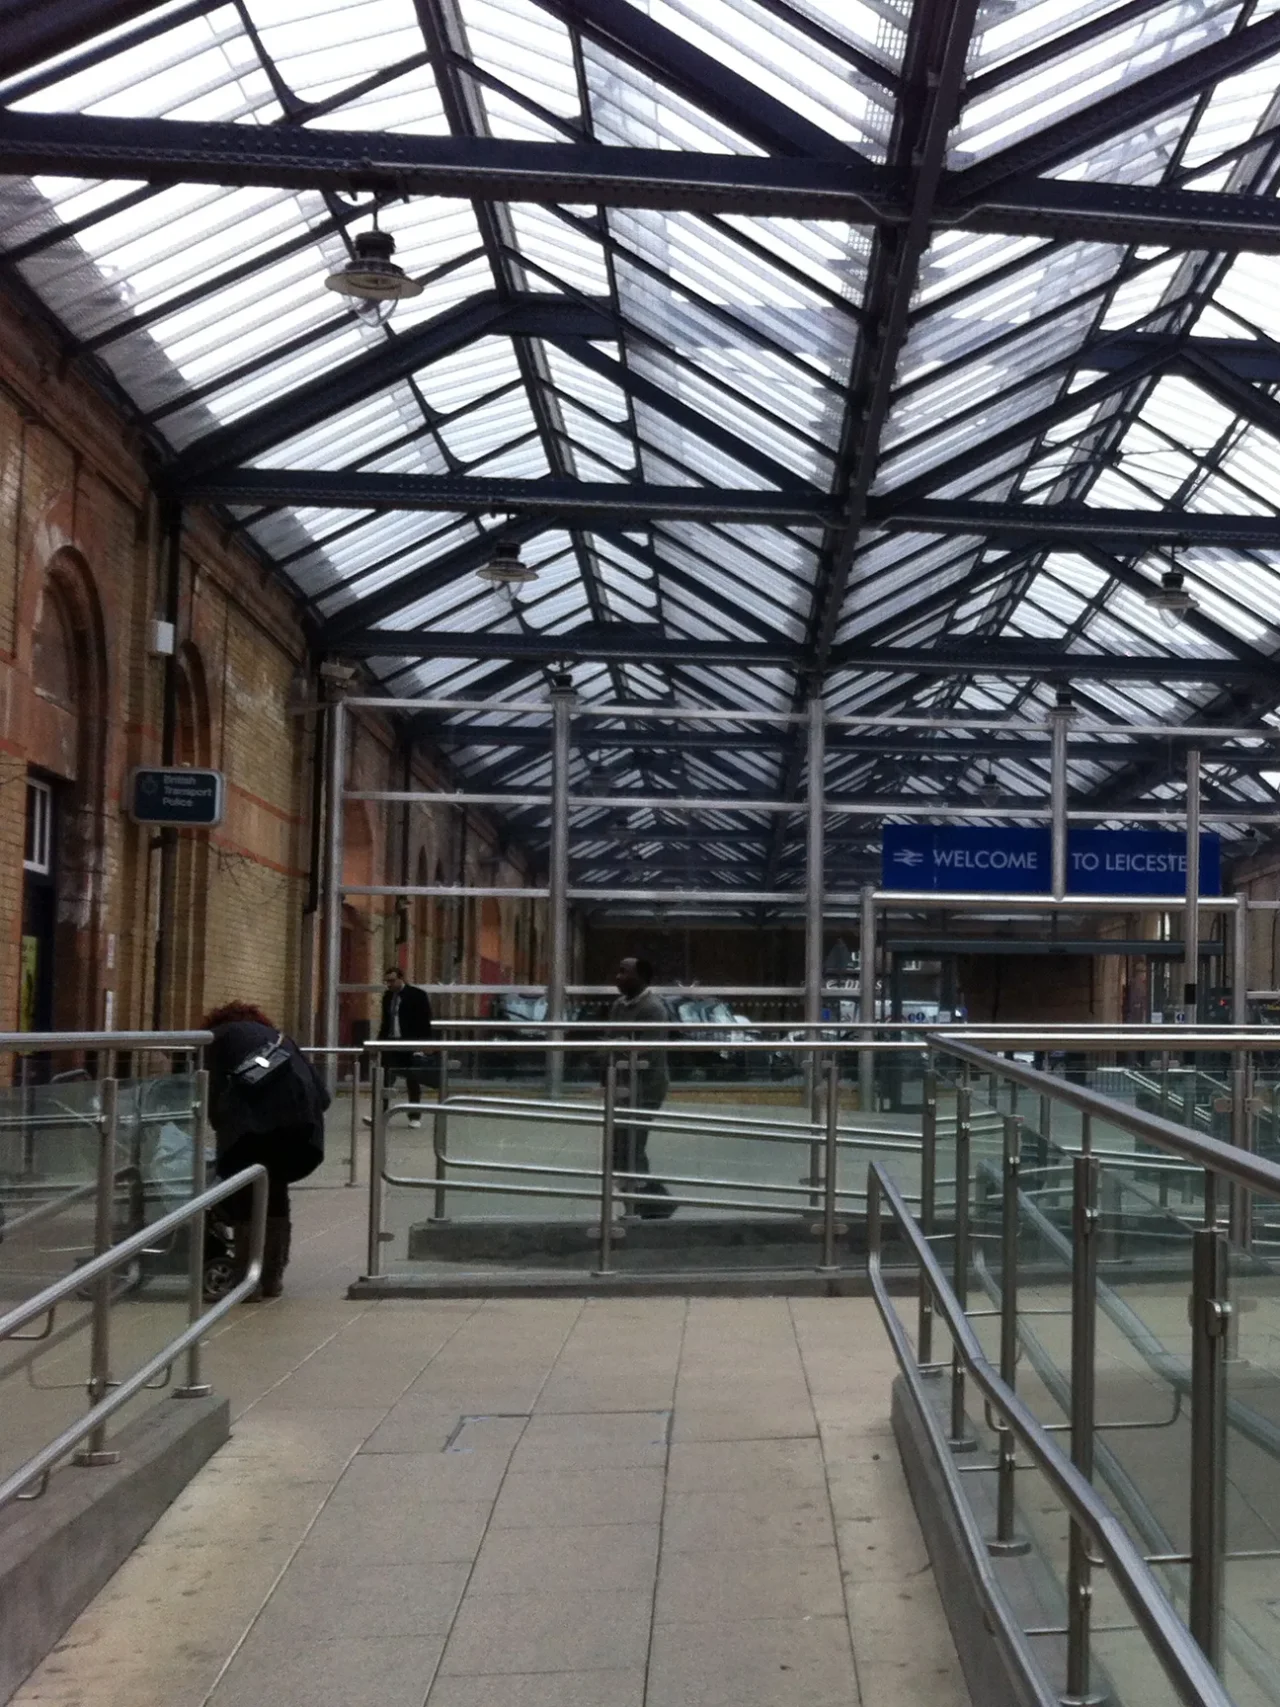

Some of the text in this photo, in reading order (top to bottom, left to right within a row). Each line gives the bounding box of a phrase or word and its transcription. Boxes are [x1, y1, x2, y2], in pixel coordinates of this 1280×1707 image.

[164, 786, 212, 797] Transport
[162, 797, 194, 807] Police
[933, 849, 1190, 872] WELCOME TO LEICESTE
